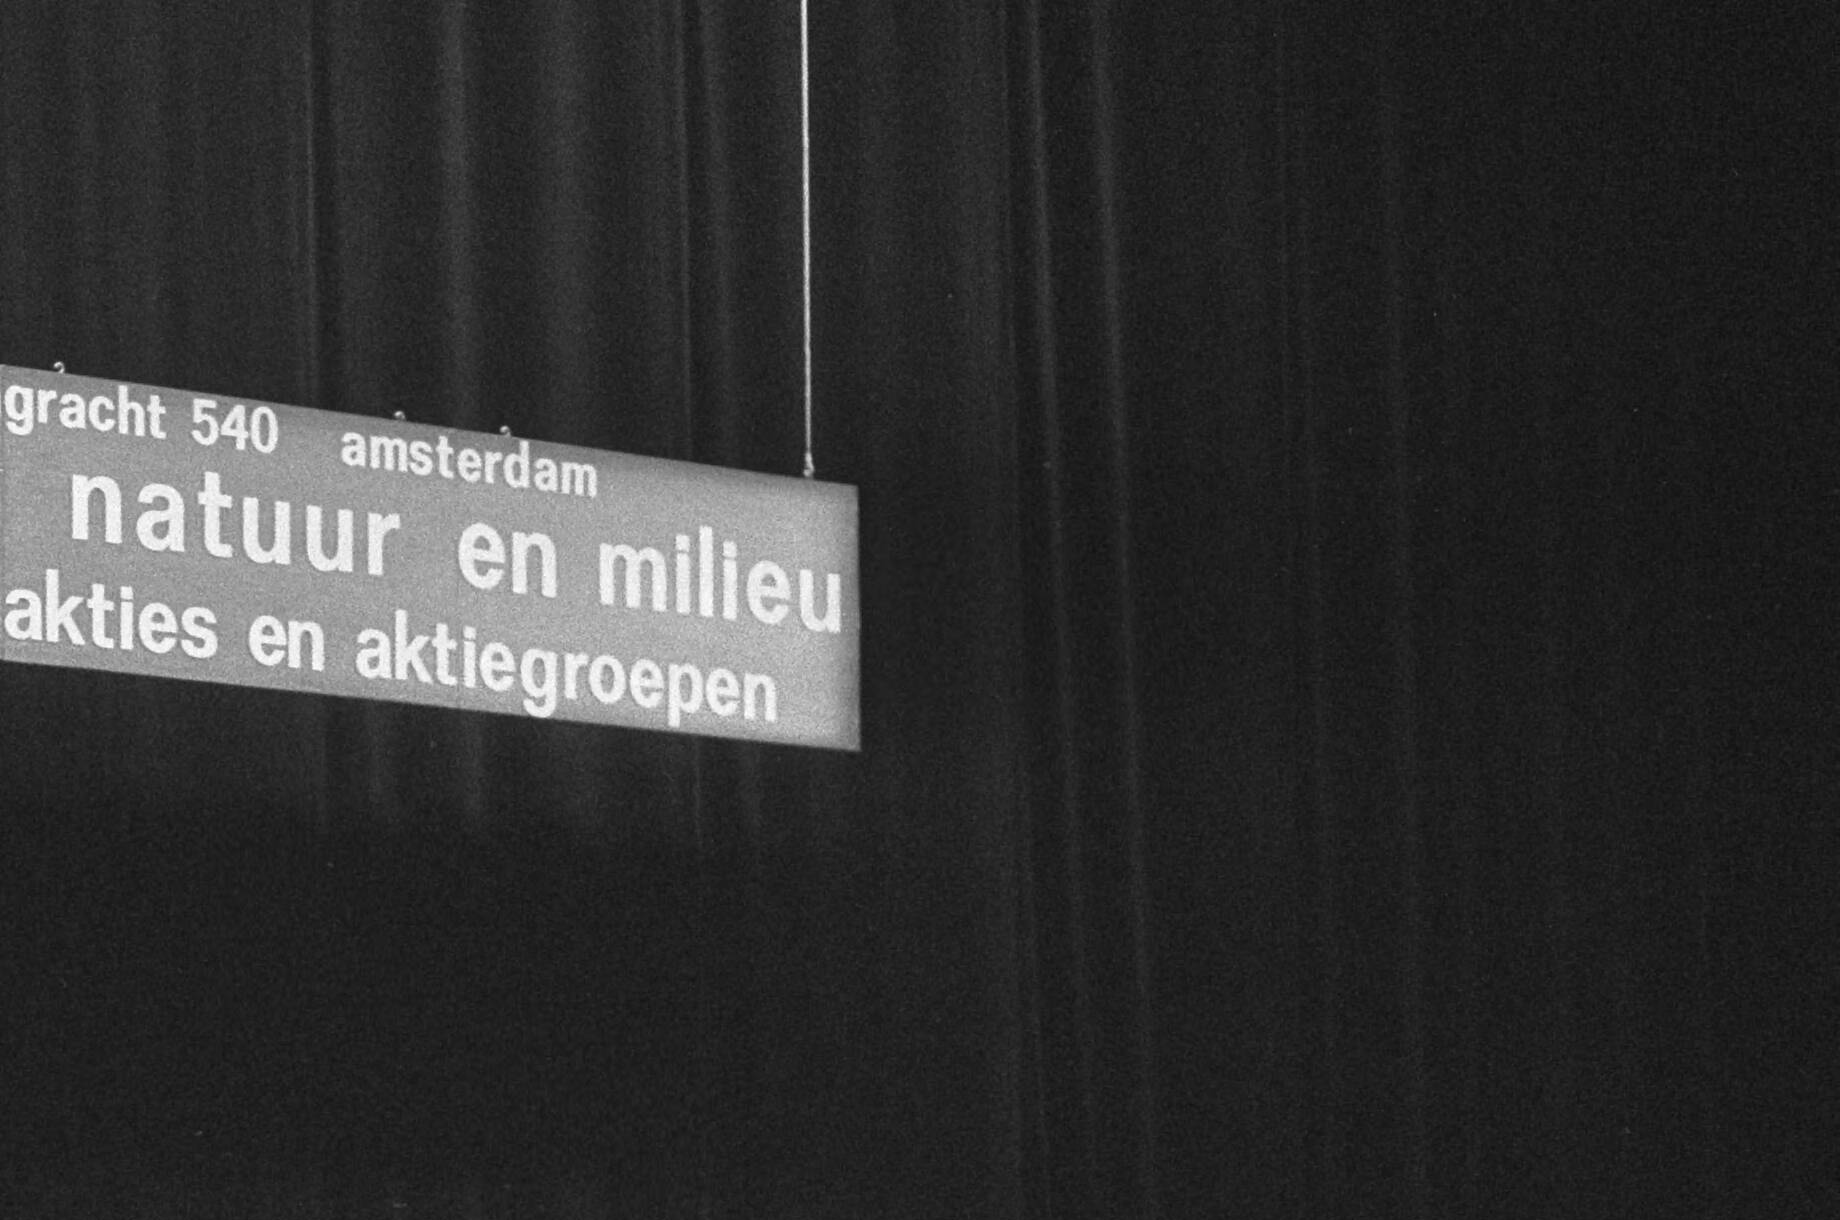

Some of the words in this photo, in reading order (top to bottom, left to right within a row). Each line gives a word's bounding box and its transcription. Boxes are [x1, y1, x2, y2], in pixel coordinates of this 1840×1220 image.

[191, 399, 279, 453] 540
[340, 430, 597, 497] amsterdam
[71, 471, 400, 576] natuur
[459, 520, 557, 598] en
[599, 526, 841, 634] milieu
[5, 570, 217, 659] akties
[249, 614, 324, 671] en
[357, 611, 777, 727] aktiegroepen
